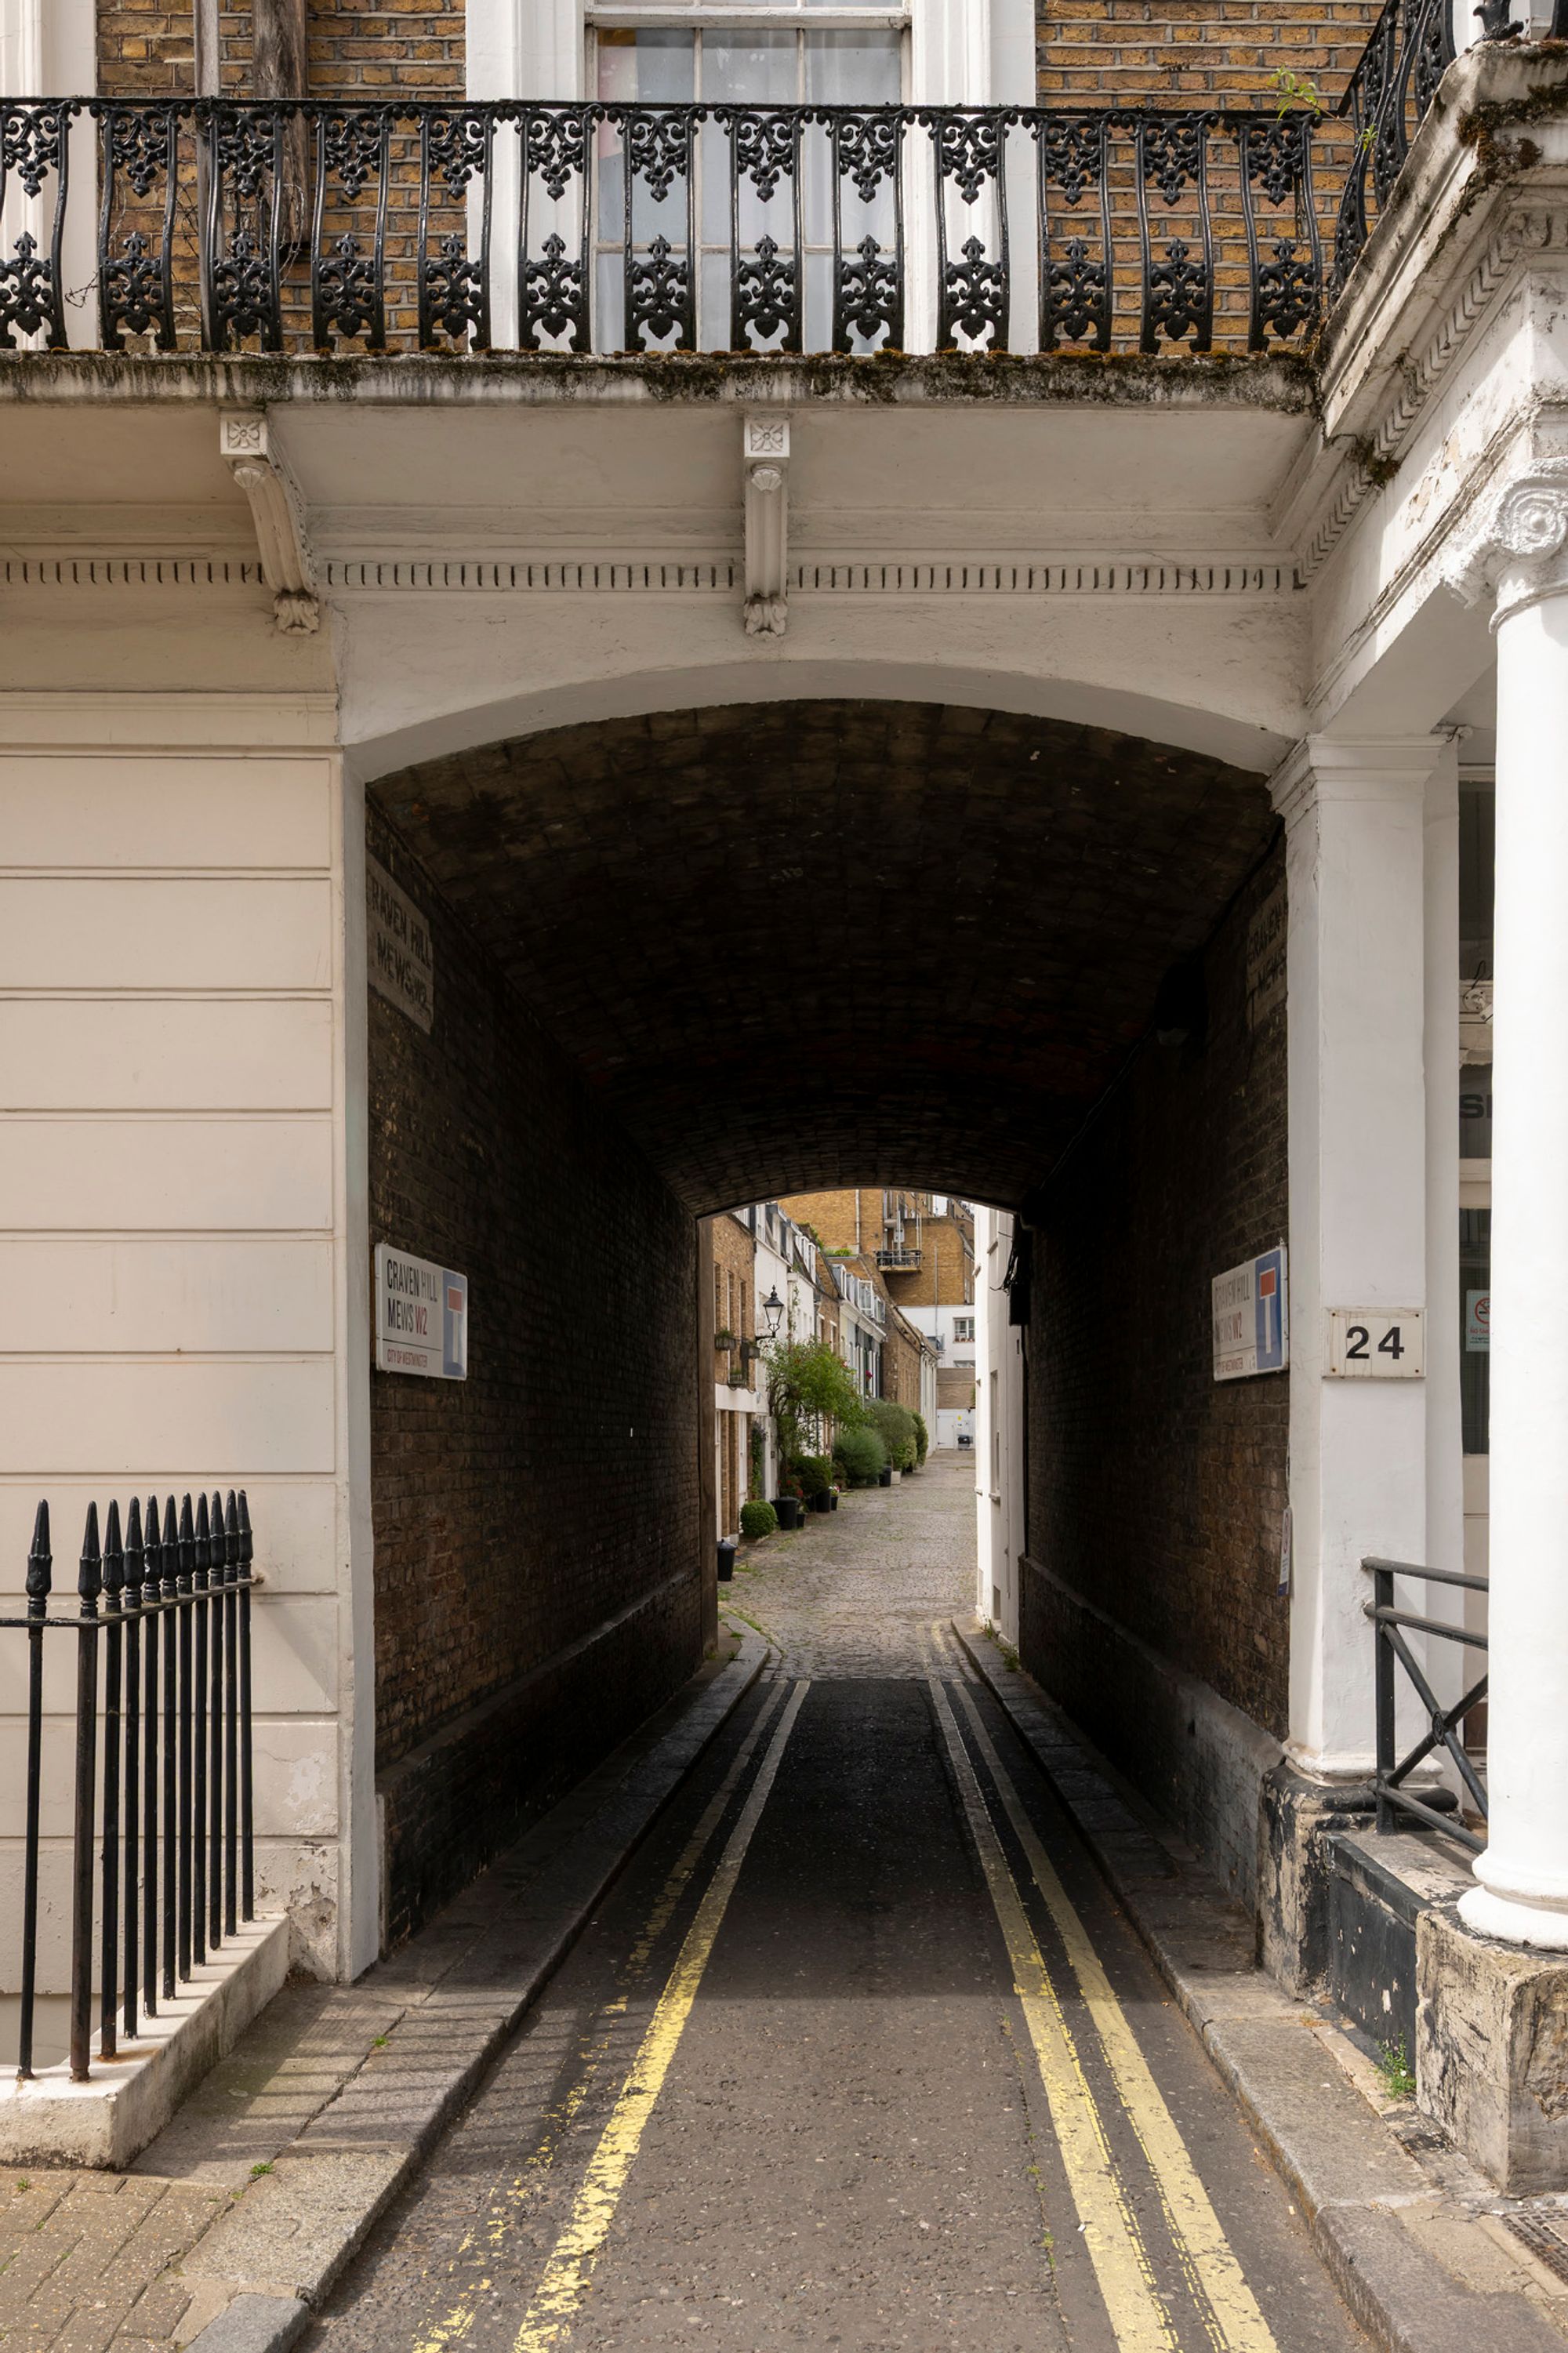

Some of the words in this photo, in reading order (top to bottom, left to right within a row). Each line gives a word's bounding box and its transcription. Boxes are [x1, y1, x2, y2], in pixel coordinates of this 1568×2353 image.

[387, 1259, 419, 1297] CRAVEN
[421, 1269, 437, 1302] HILL
[388, 1298, 414, 1333] MEWS
[415, 1305, 428, 1335] W2
[1346, 1326, 1404, 1360] 24
